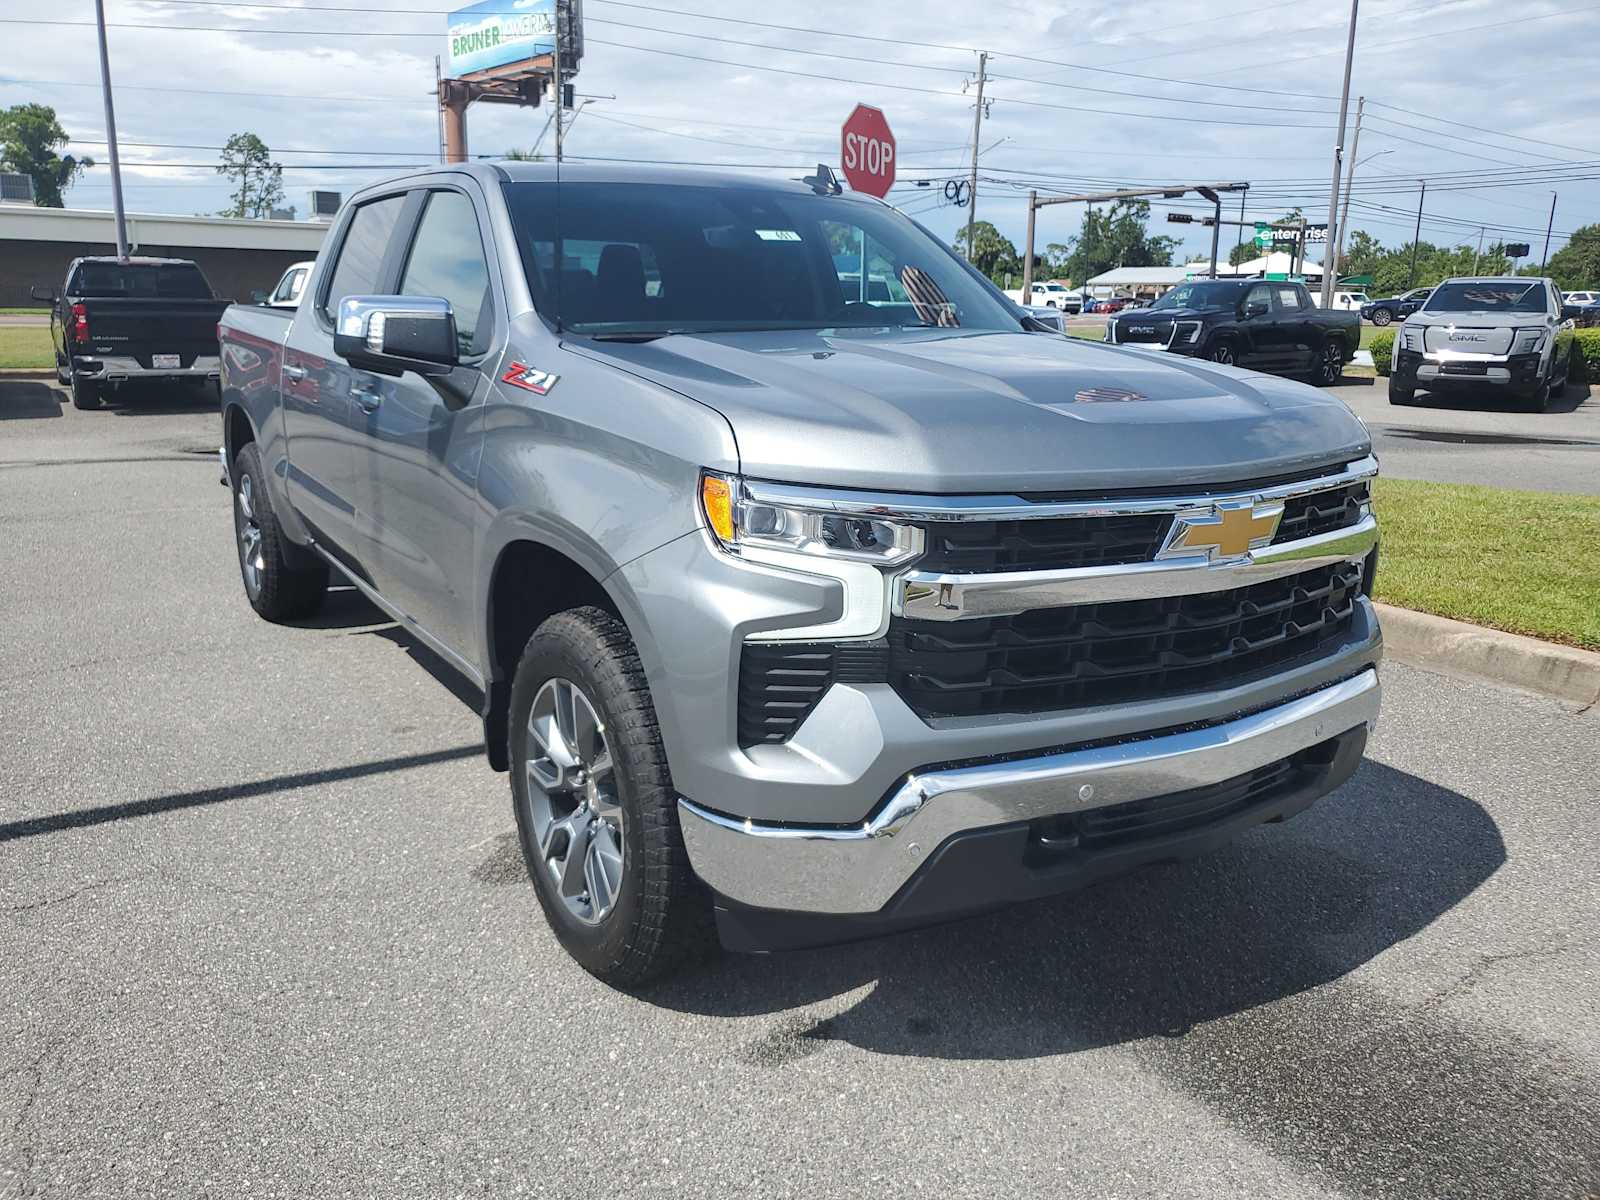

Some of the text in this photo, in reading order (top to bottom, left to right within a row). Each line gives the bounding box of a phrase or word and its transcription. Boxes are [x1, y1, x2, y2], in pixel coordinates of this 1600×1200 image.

[452, 26, 500, 57] BRUNER
[845, 132, 893, 177] STOP
[1448, 334, 1488, 342] GMC
[502, 361, 561, 395] Z71
